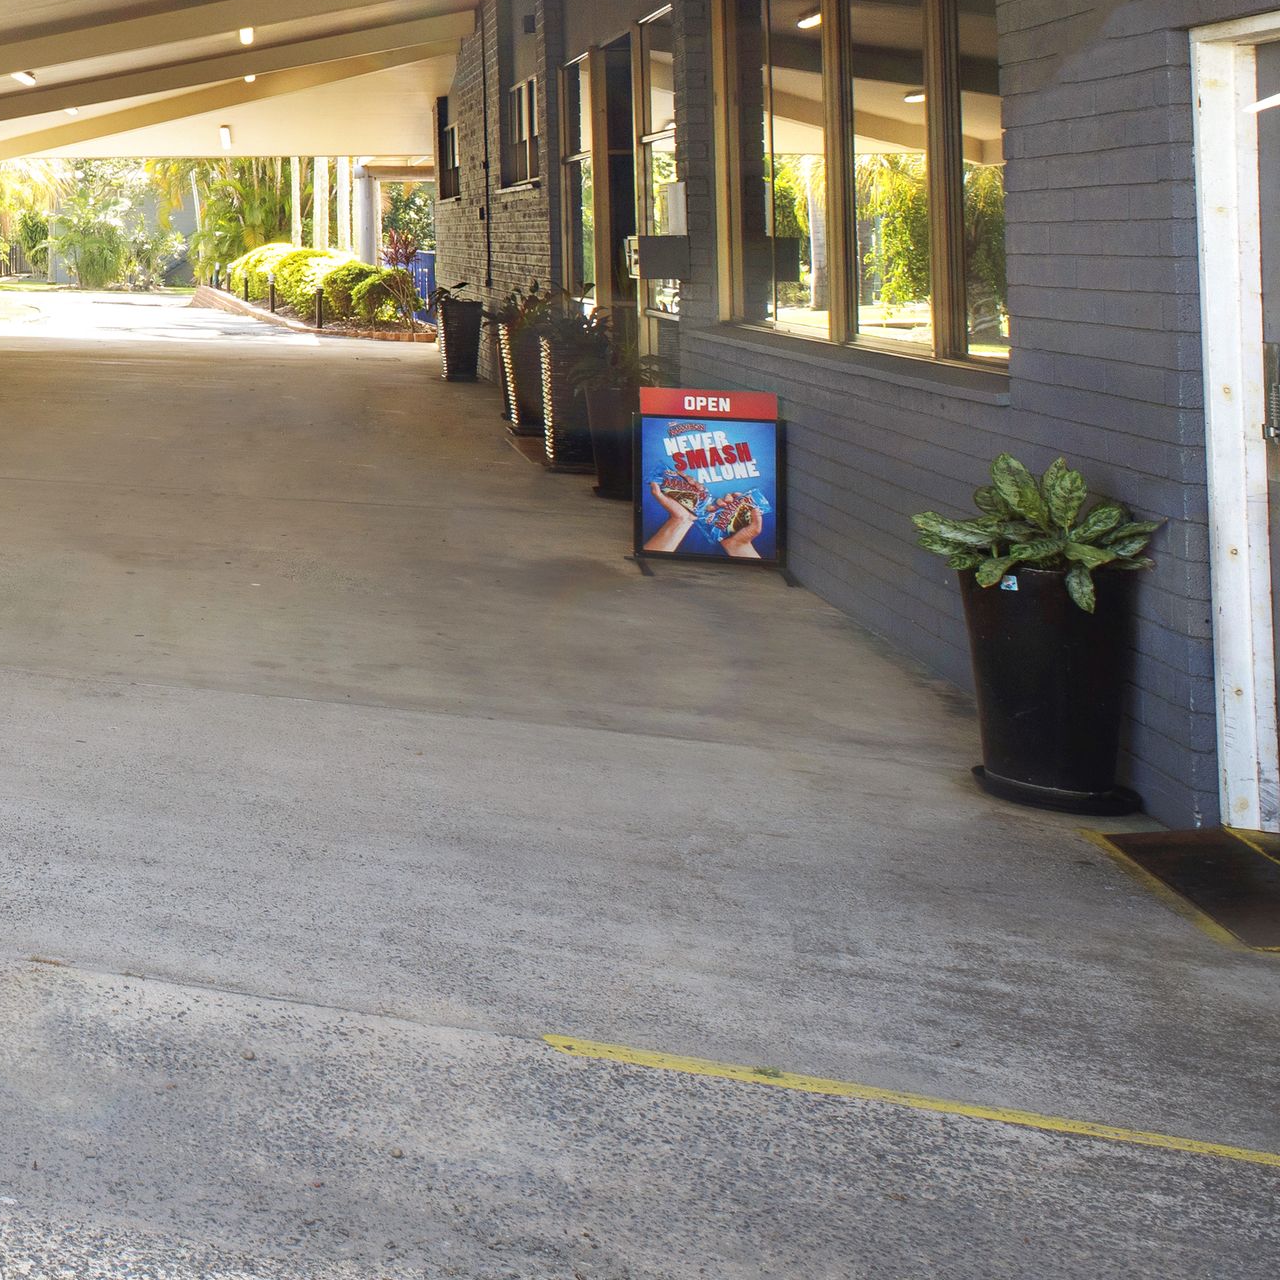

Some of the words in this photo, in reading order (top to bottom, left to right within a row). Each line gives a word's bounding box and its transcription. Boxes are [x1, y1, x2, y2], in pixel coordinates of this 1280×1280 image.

[684, 396, 731, 412] OPEN
[663, 431, 729, 456] NEVER
[672, 442, 752, 471] SMASH
[697, 458, 760, 484] ALONE
